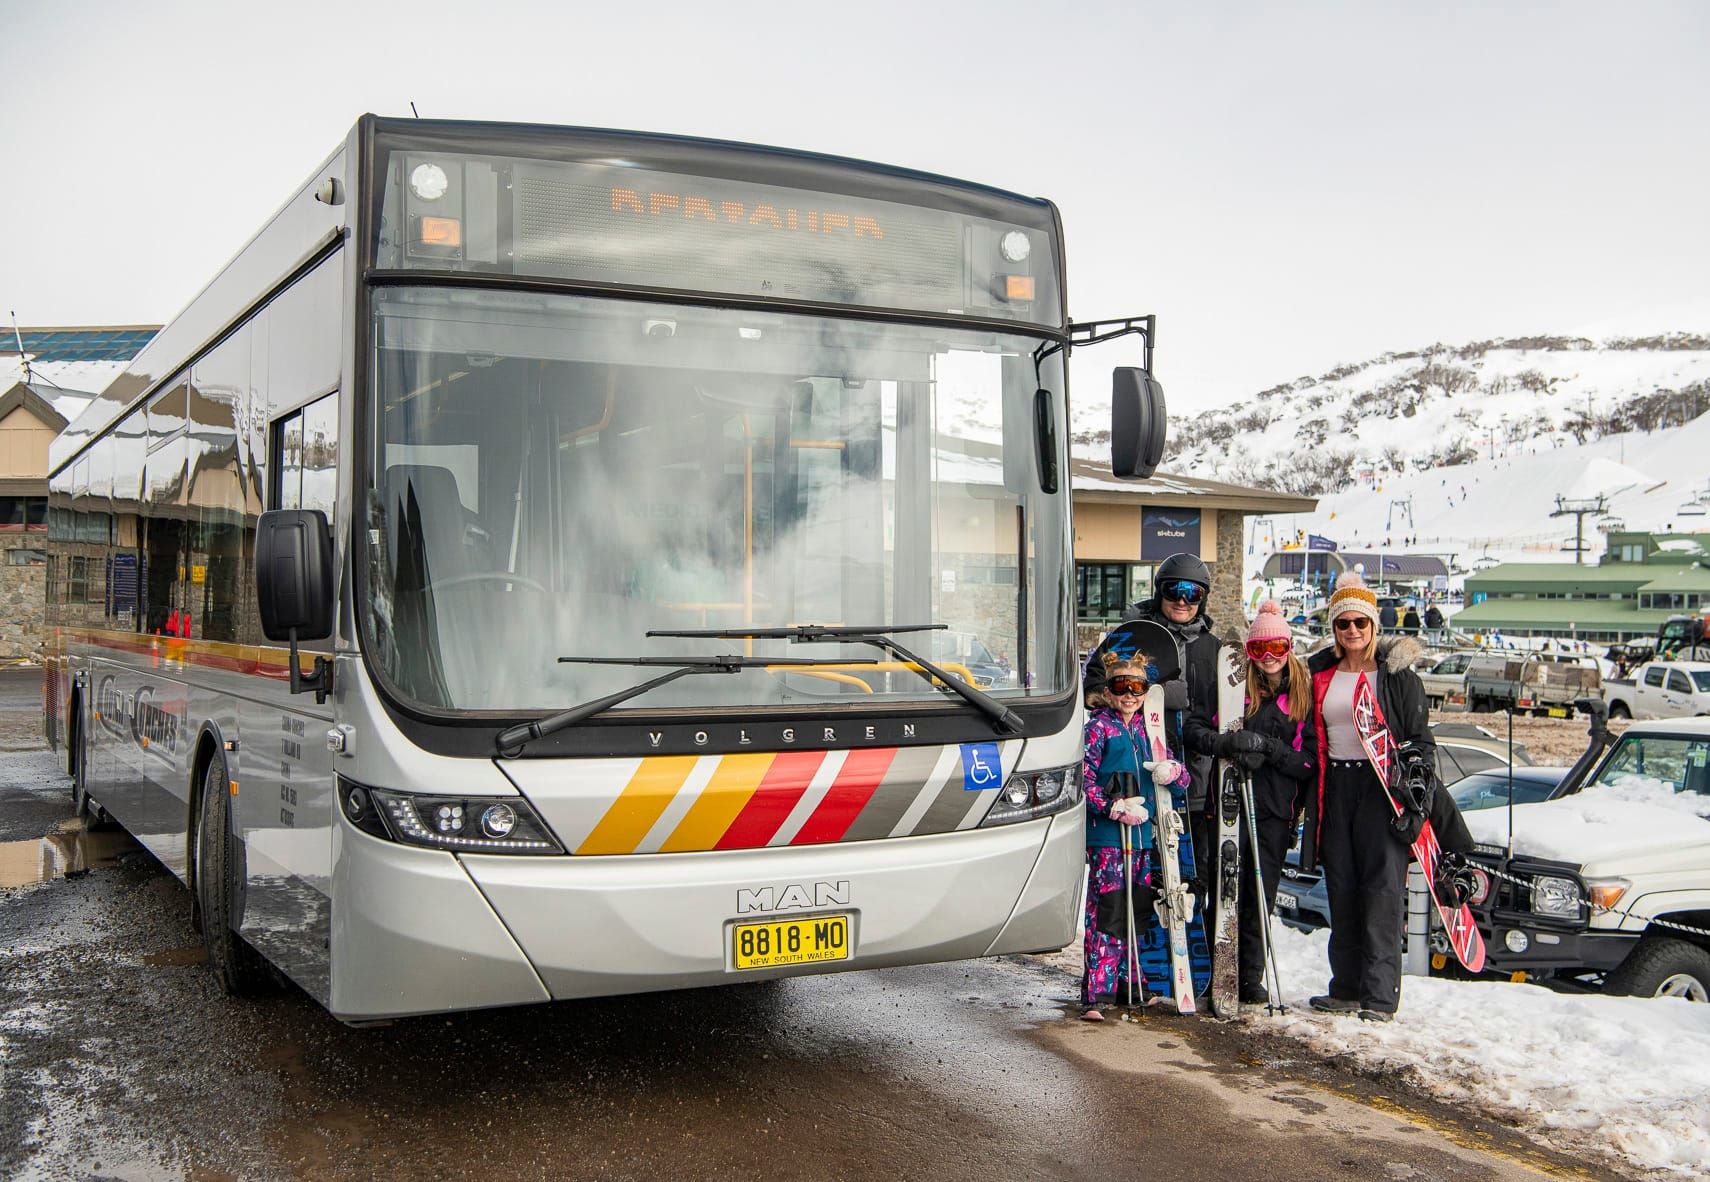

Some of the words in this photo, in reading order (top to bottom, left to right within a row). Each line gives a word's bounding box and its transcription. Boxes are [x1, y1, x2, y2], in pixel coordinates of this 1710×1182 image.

[649, 723, 916, 746] VOLGREN
[737, 880, 850, 914] MAN
[750, 958, 770, 966] NEW
[774, 954, 803, 964] SOUTH
[807, 950, 836, 960] WALES
